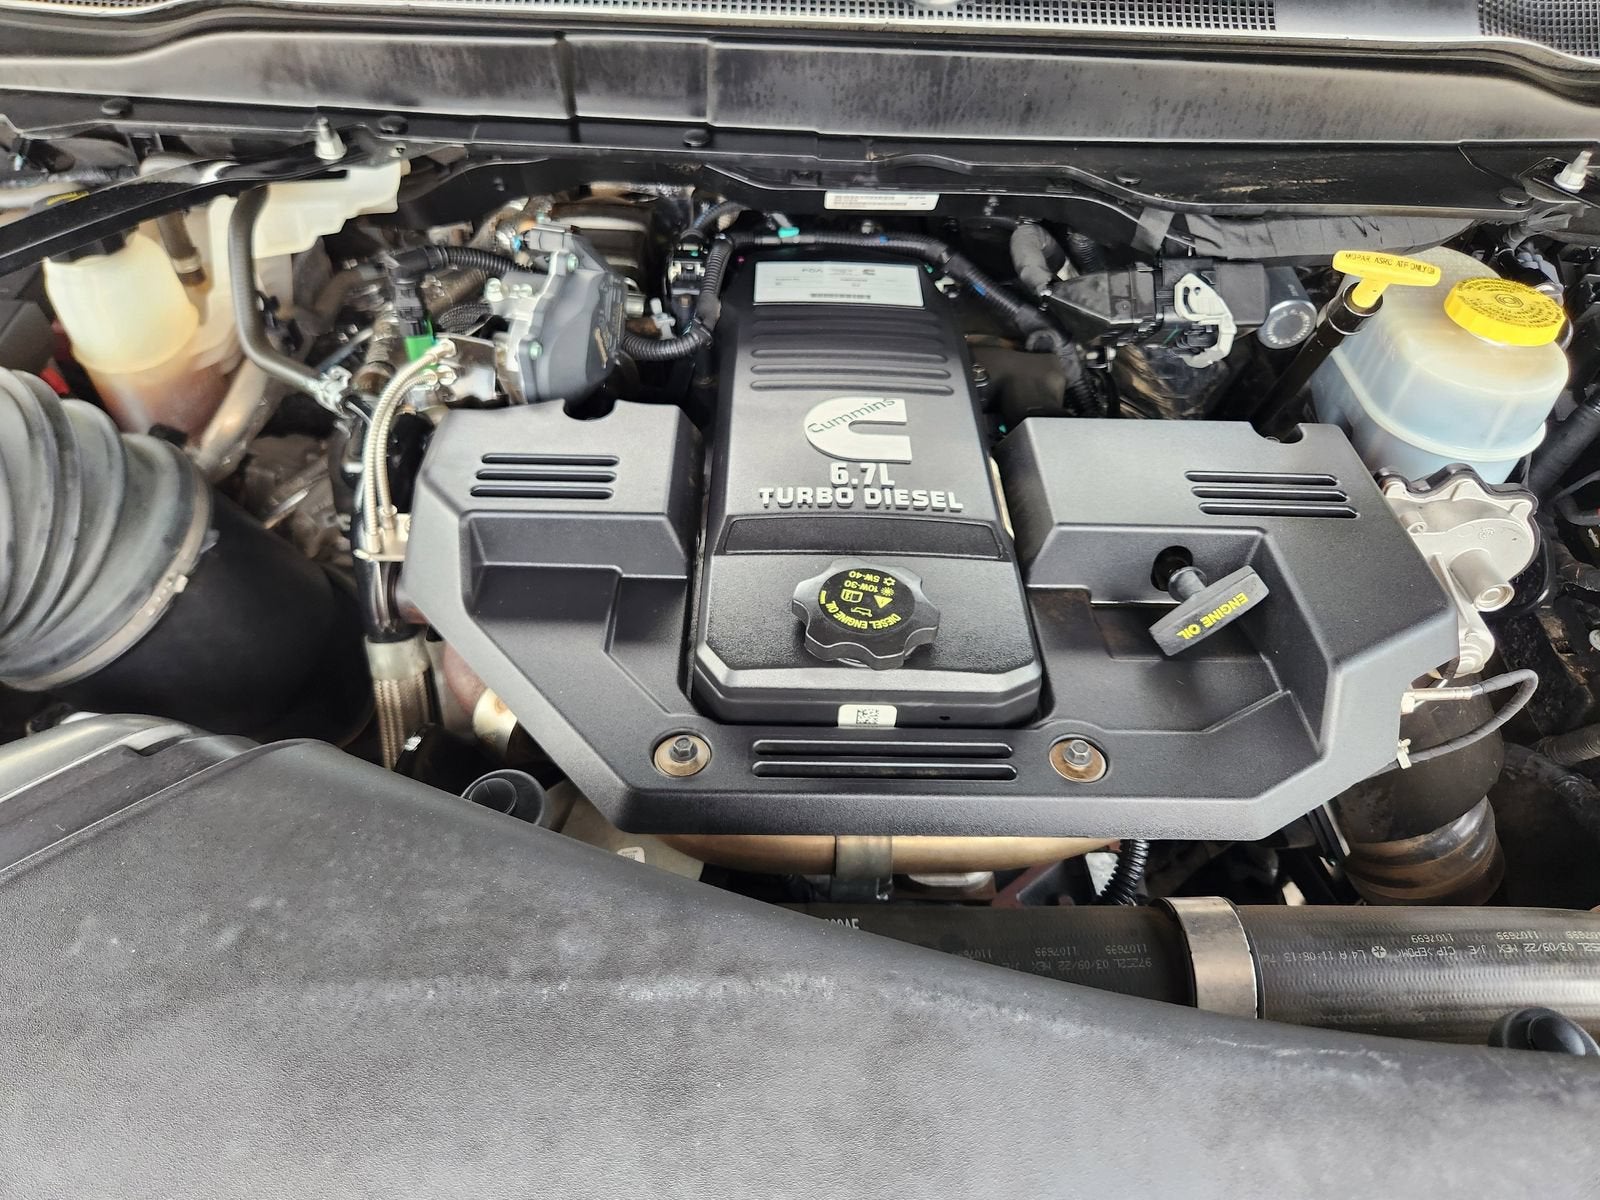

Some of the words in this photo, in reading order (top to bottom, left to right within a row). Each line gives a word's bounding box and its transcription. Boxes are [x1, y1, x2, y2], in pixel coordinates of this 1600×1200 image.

[1345, 253, 1371, 262] MOPAR
[1396, 260, 1409, 268] ATF
[807, 397, 896, 433] Cummins
[830, 462, 895, 488] 6.7L
[758, 486, 854, 508] TURBO
[864, 487, 964, 512] DIESEL
[849, 571, 881, 583] 5W-40
[844, 580, 879, 593] 10W-30
[825, 600, 840, 613] OIL
[1200, 592, 1249, 628] ENGINE
[833, 610, 868, 629] ENGINE
[869, 613, 902, 629] DIESEL
[1176, 624, 1201, 640] OIL
[1411, 934, 1454, 943] 1107699
[1035, 946, 1077, 957] 1107699
[1436, 945, 1456, 956] CIP
[1497, 943, 1518, 953] MEX
[1522, 942, 1574, 952] 03/09/22
[1058, 959, 1109, 970] 03/09/22
